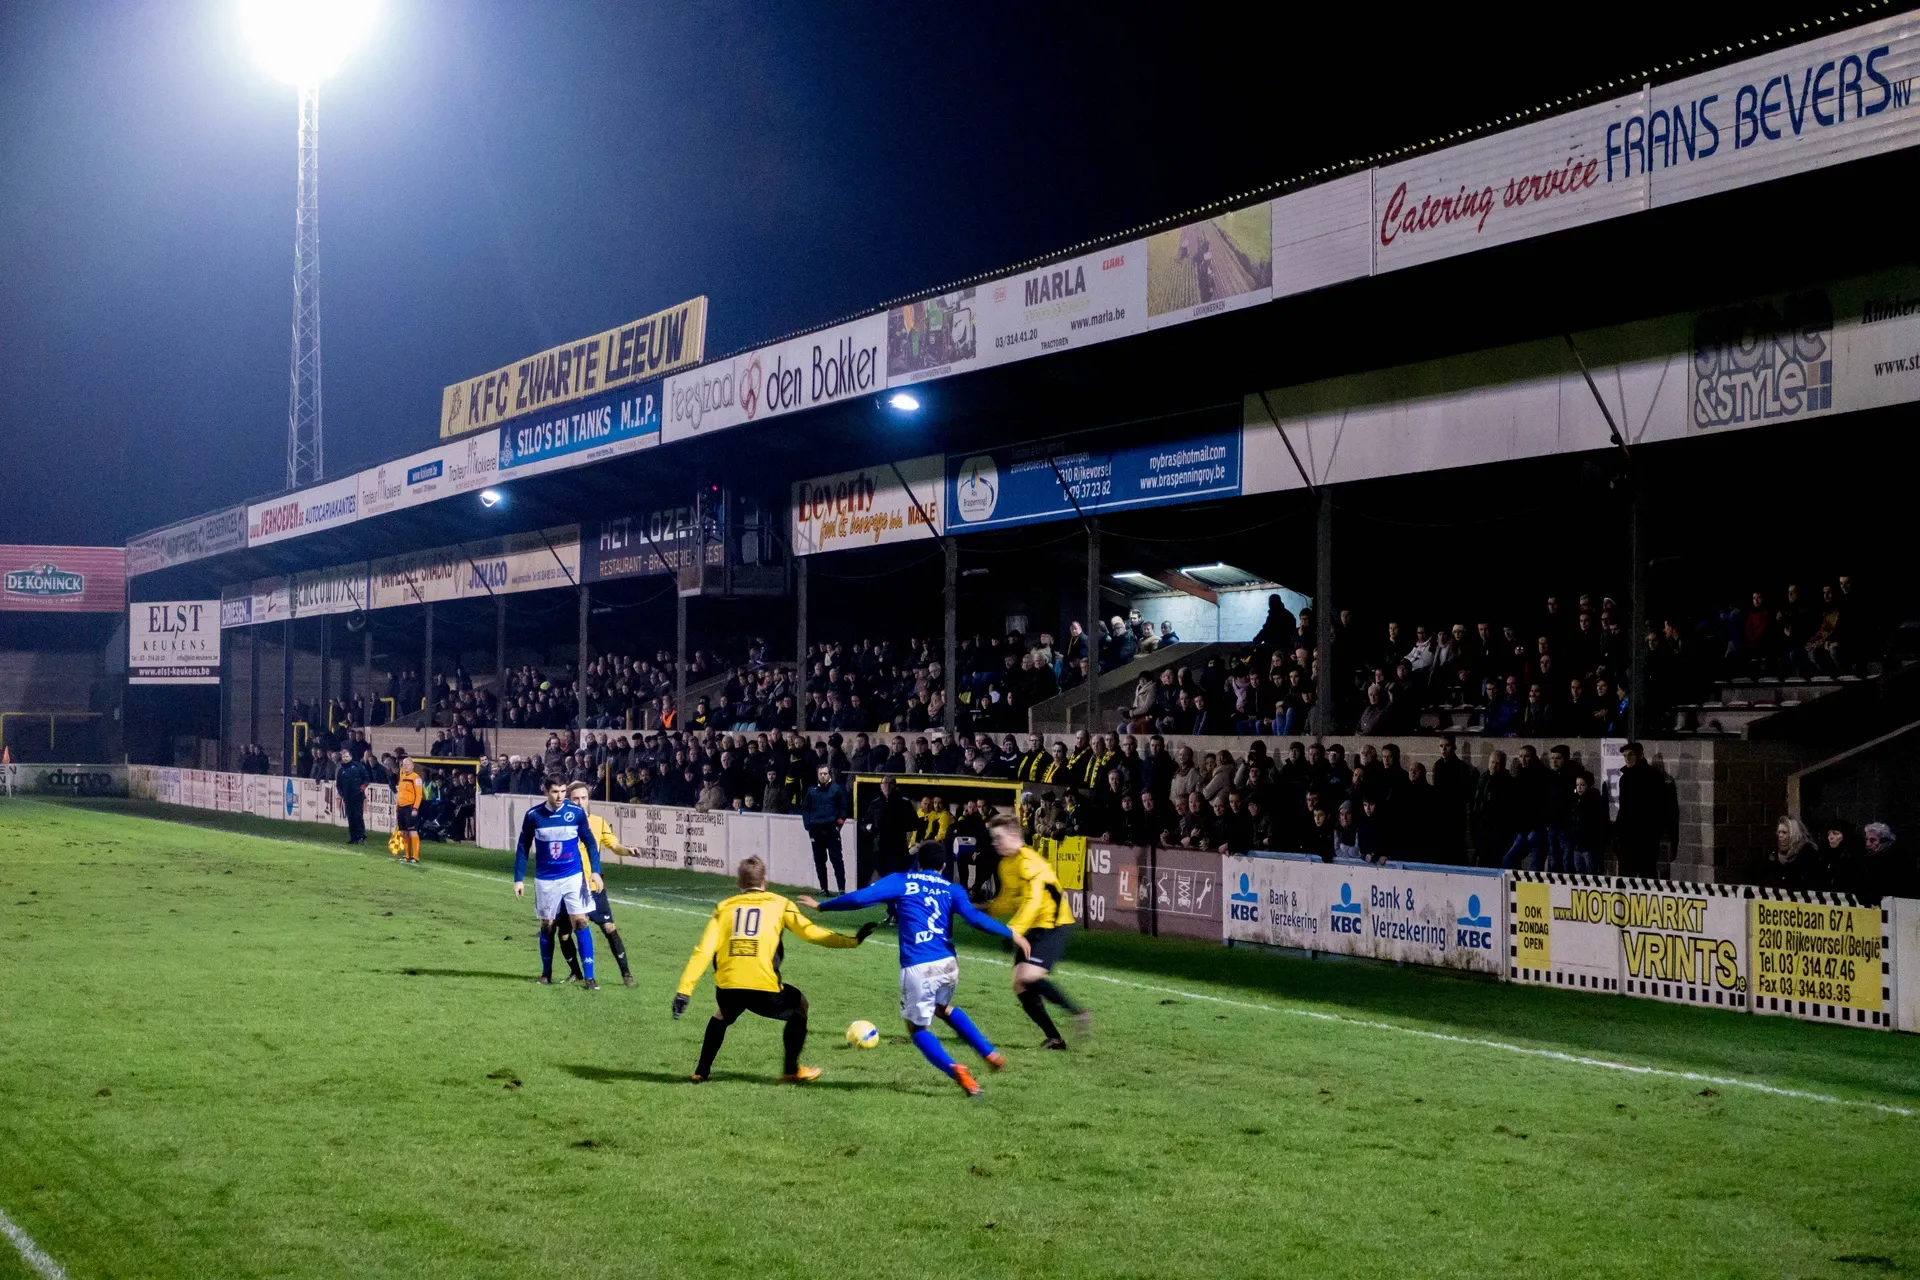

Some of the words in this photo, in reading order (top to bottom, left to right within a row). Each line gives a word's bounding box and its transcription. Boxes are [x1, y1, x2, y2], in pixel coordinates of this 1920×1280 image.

[1606, 93, 1719, 183] FRANS
[1734, 45, 1892, 150] BEVERS
[1893, 78, 1913, 109] NV
[1380, 181, 1495, 246] Catering
[1503, 156, 1600, 208] service
[1025, 265, 1086, 307] MARLA
[1070, 307, 1125, 330] www.marla.be
[995, 328, 1038, 348] 03/314.41.20
[1041, 336, 1069, 350] TRACTOREN
[468, 368, 509, 425] KFC
[516, 340, 600, 410] ZWARTE
[605, 308, 687, 383] LEEUW
[766, 355, 802, 411] den
[812, 336, 877, 403] Bakker
[1874, 354, 1920, 377] www.st
[517, 423, 552, 457] SILO'S
[555, 417, 570, 446] EN
[572, 405, 611, 440] TANKS
[621, 394, 656, 431] M.I.P.
[1149, 445, 1226, 471] roybras@hotmail.com
[1073, 461, 1112, 484] Rijkevorsel
[1139, 464, 1226, 490] www.braspenningroy.be
[798, 471, 878, 522] Beverly
[1080, 483, 1091, 499] 37
[1091, 481, 1101, 497] 23
[1101, 480, 1111, 496] 82
[305, 494, 356, 525] AUTOCARVAKANTIES
[600, 516, 632, 551] HET
[600, 555, 642, 576] RESTAURANT
[648, 548, 691, 570] BRASSERIE
[7, 575, 24, 589] DE
[26, 575, 82, 591] KONINCK
[148, 604, 203, 639] ELST
[143, 639, 205, 651] KEUKENS
[138, 666, 210, 677] www.elst-keukens.be
[1090, 894, 1105, 923] 90
[1269, 889, 1288, 907] Bank
[1291, 890, 1298, 907] &
[1371, 884, 1401, 911] Bank
[1405, 887, 1415, 911] &
[734, 907, 760, 936] 10
[924, 896, 944, 934] 2
[1231, 904, 1258, 922] KBC
[1270, 909, 1318, 934] Verzekering
[1331, 914, 1362, 935] KBC
[1524, 905, 1542, 918] OOK
[1758, 903, 1825, 931] Beersebaan
[1829, 909, 1843, 932] 67
[1845, 911, 1854, 933] A
[1371, 914, 1446, 951] Verzekering
[1457, 928, 1492, 950] KBC
[1518, 920, 1549, 935] ZONDAG
[1758, 928, 1782, 949] 2310
[1523, 938, 1544, 951] OPEN
[1779, 953, 1793, 975] 03
[1802, 955, 1856, 982] 314.47.46
[1759, 975, 1777, 993] Fax
[1780, 977, 1793, 996] 03
[1799, 979, 1851, 1003] 314.83.35
